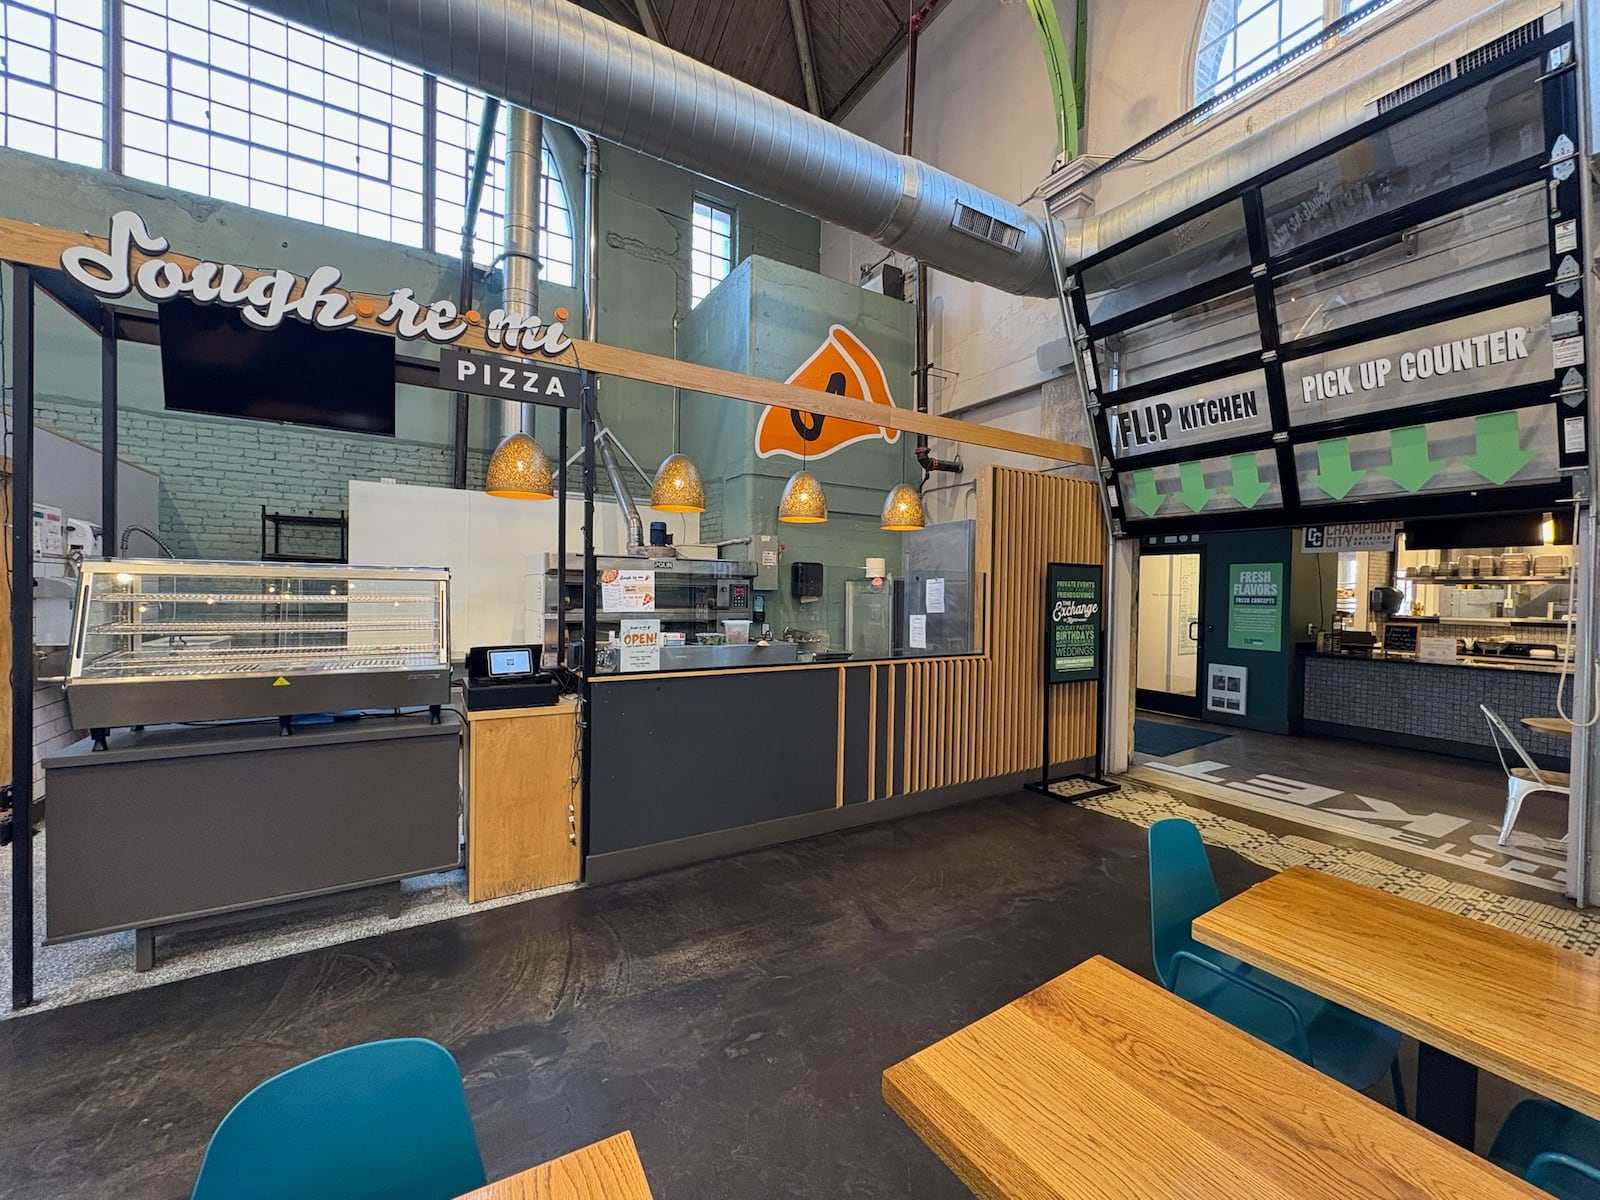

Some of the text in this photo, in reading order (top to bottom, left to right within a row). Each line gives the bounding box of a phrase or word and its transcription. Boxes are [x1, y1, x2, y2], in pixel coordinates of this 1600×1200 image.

[1302, 365, 1353, 404] PICK
[1358, 358, 1392, 391] UP
[1400, 326, 1528, 382] COUNTER
[457, 359, 566, 398] PIZZA
[1179, 390, 1258, 432] KITCHEN
[1326, 522, 1391, 536] CHAMPION
[1325, 535, 1353, 548] CITY
[1240, 570, 1271, 583] FRESH
[1233, 583, 1278, 596] FLAVORS
[1052, 600, 1098, 622] Exchange
[623, 632, 657, 645] OPEN!
[1055, 630, 1095, 641] BIRTHDAYS
[1055, 646, 1095, 657] WEDDINGS
